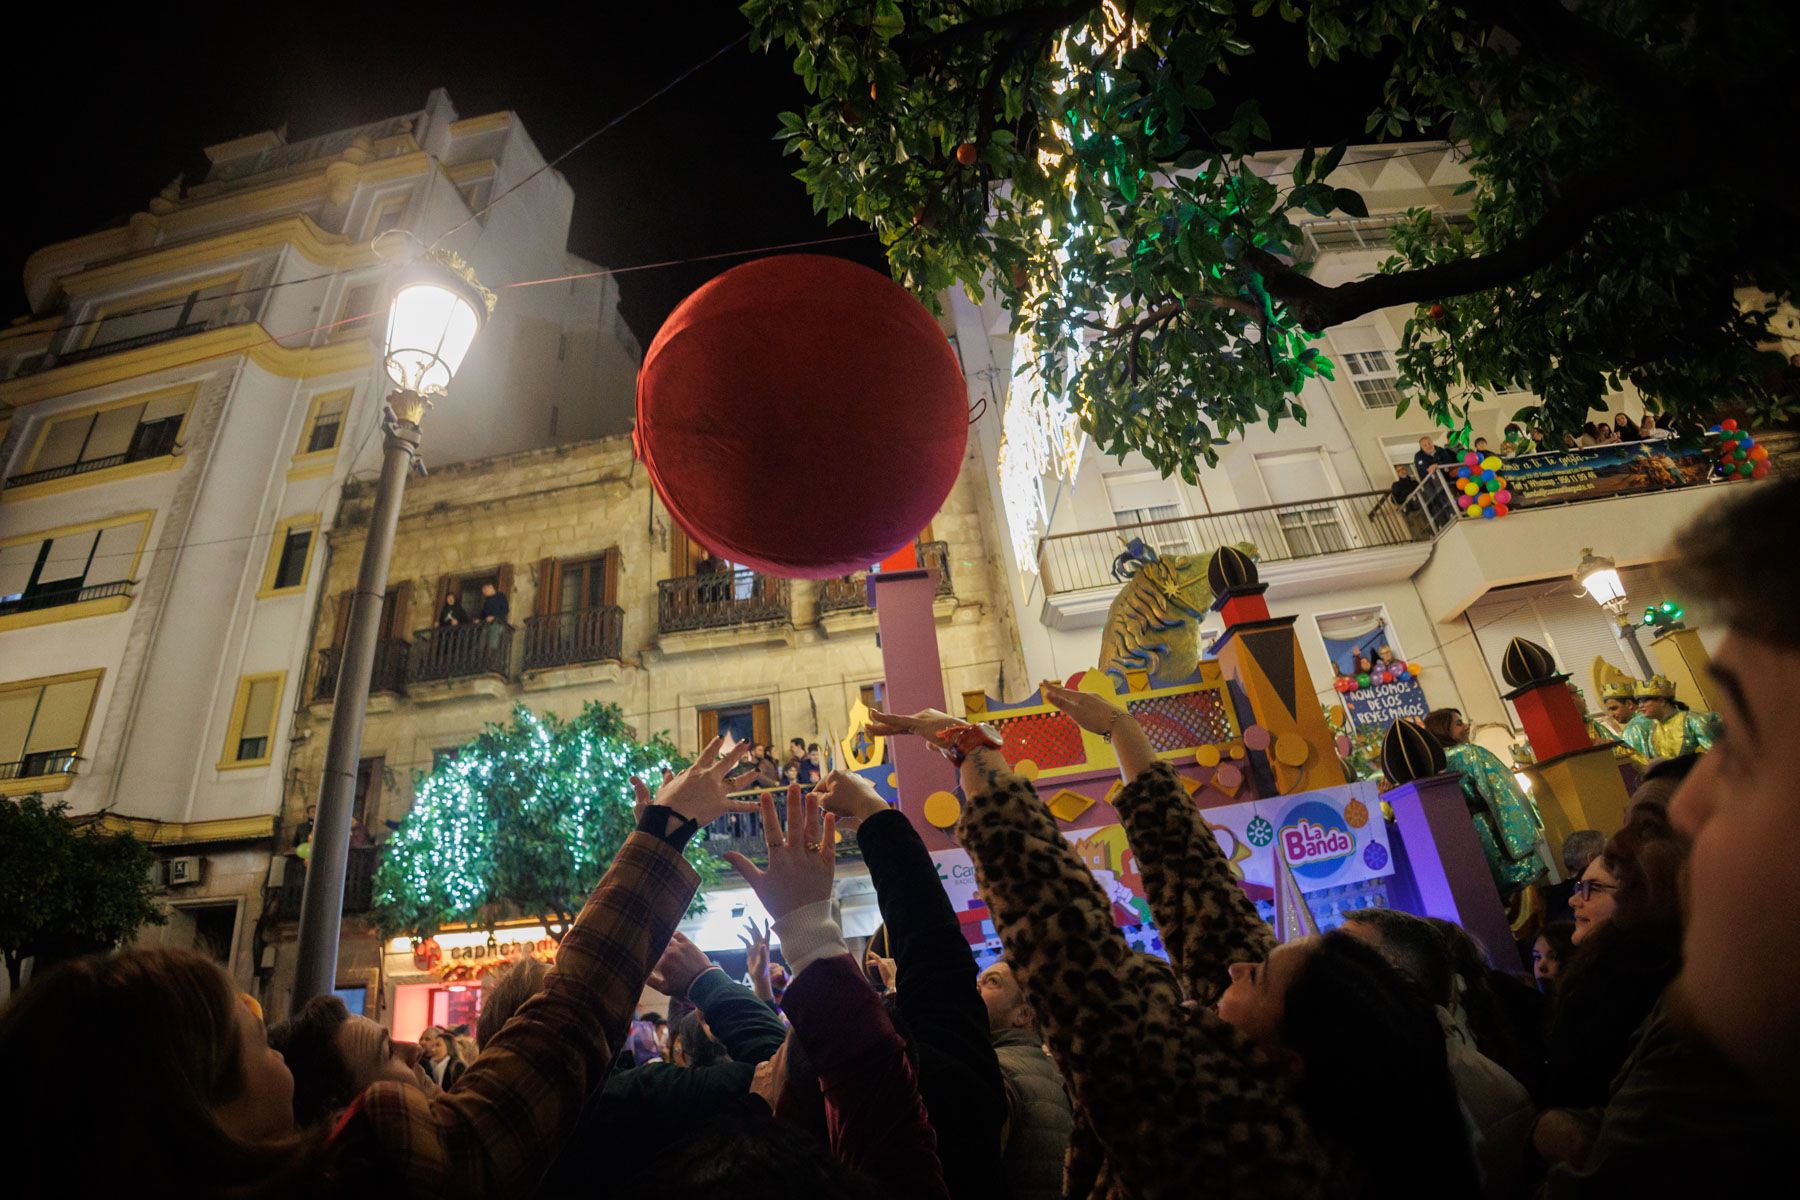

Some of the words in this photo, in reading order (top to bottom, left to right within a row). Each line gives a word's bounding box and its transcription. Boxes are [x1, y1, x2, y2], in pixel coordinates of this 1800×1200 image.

[1350, 686, 1375, 701] AQUÍ
[1376, 682, 1410, 697] SOMOS
[1367, 698, 1382, 711] DE
[1381, 694, 1402, 708] LOS
[1356, 708, 1389, 724] REYES
[1389, 703, 1423, 719] MAGOS
[1303, 824, 1322, 842] La
[1286, 831, 1348, 860] Banda
